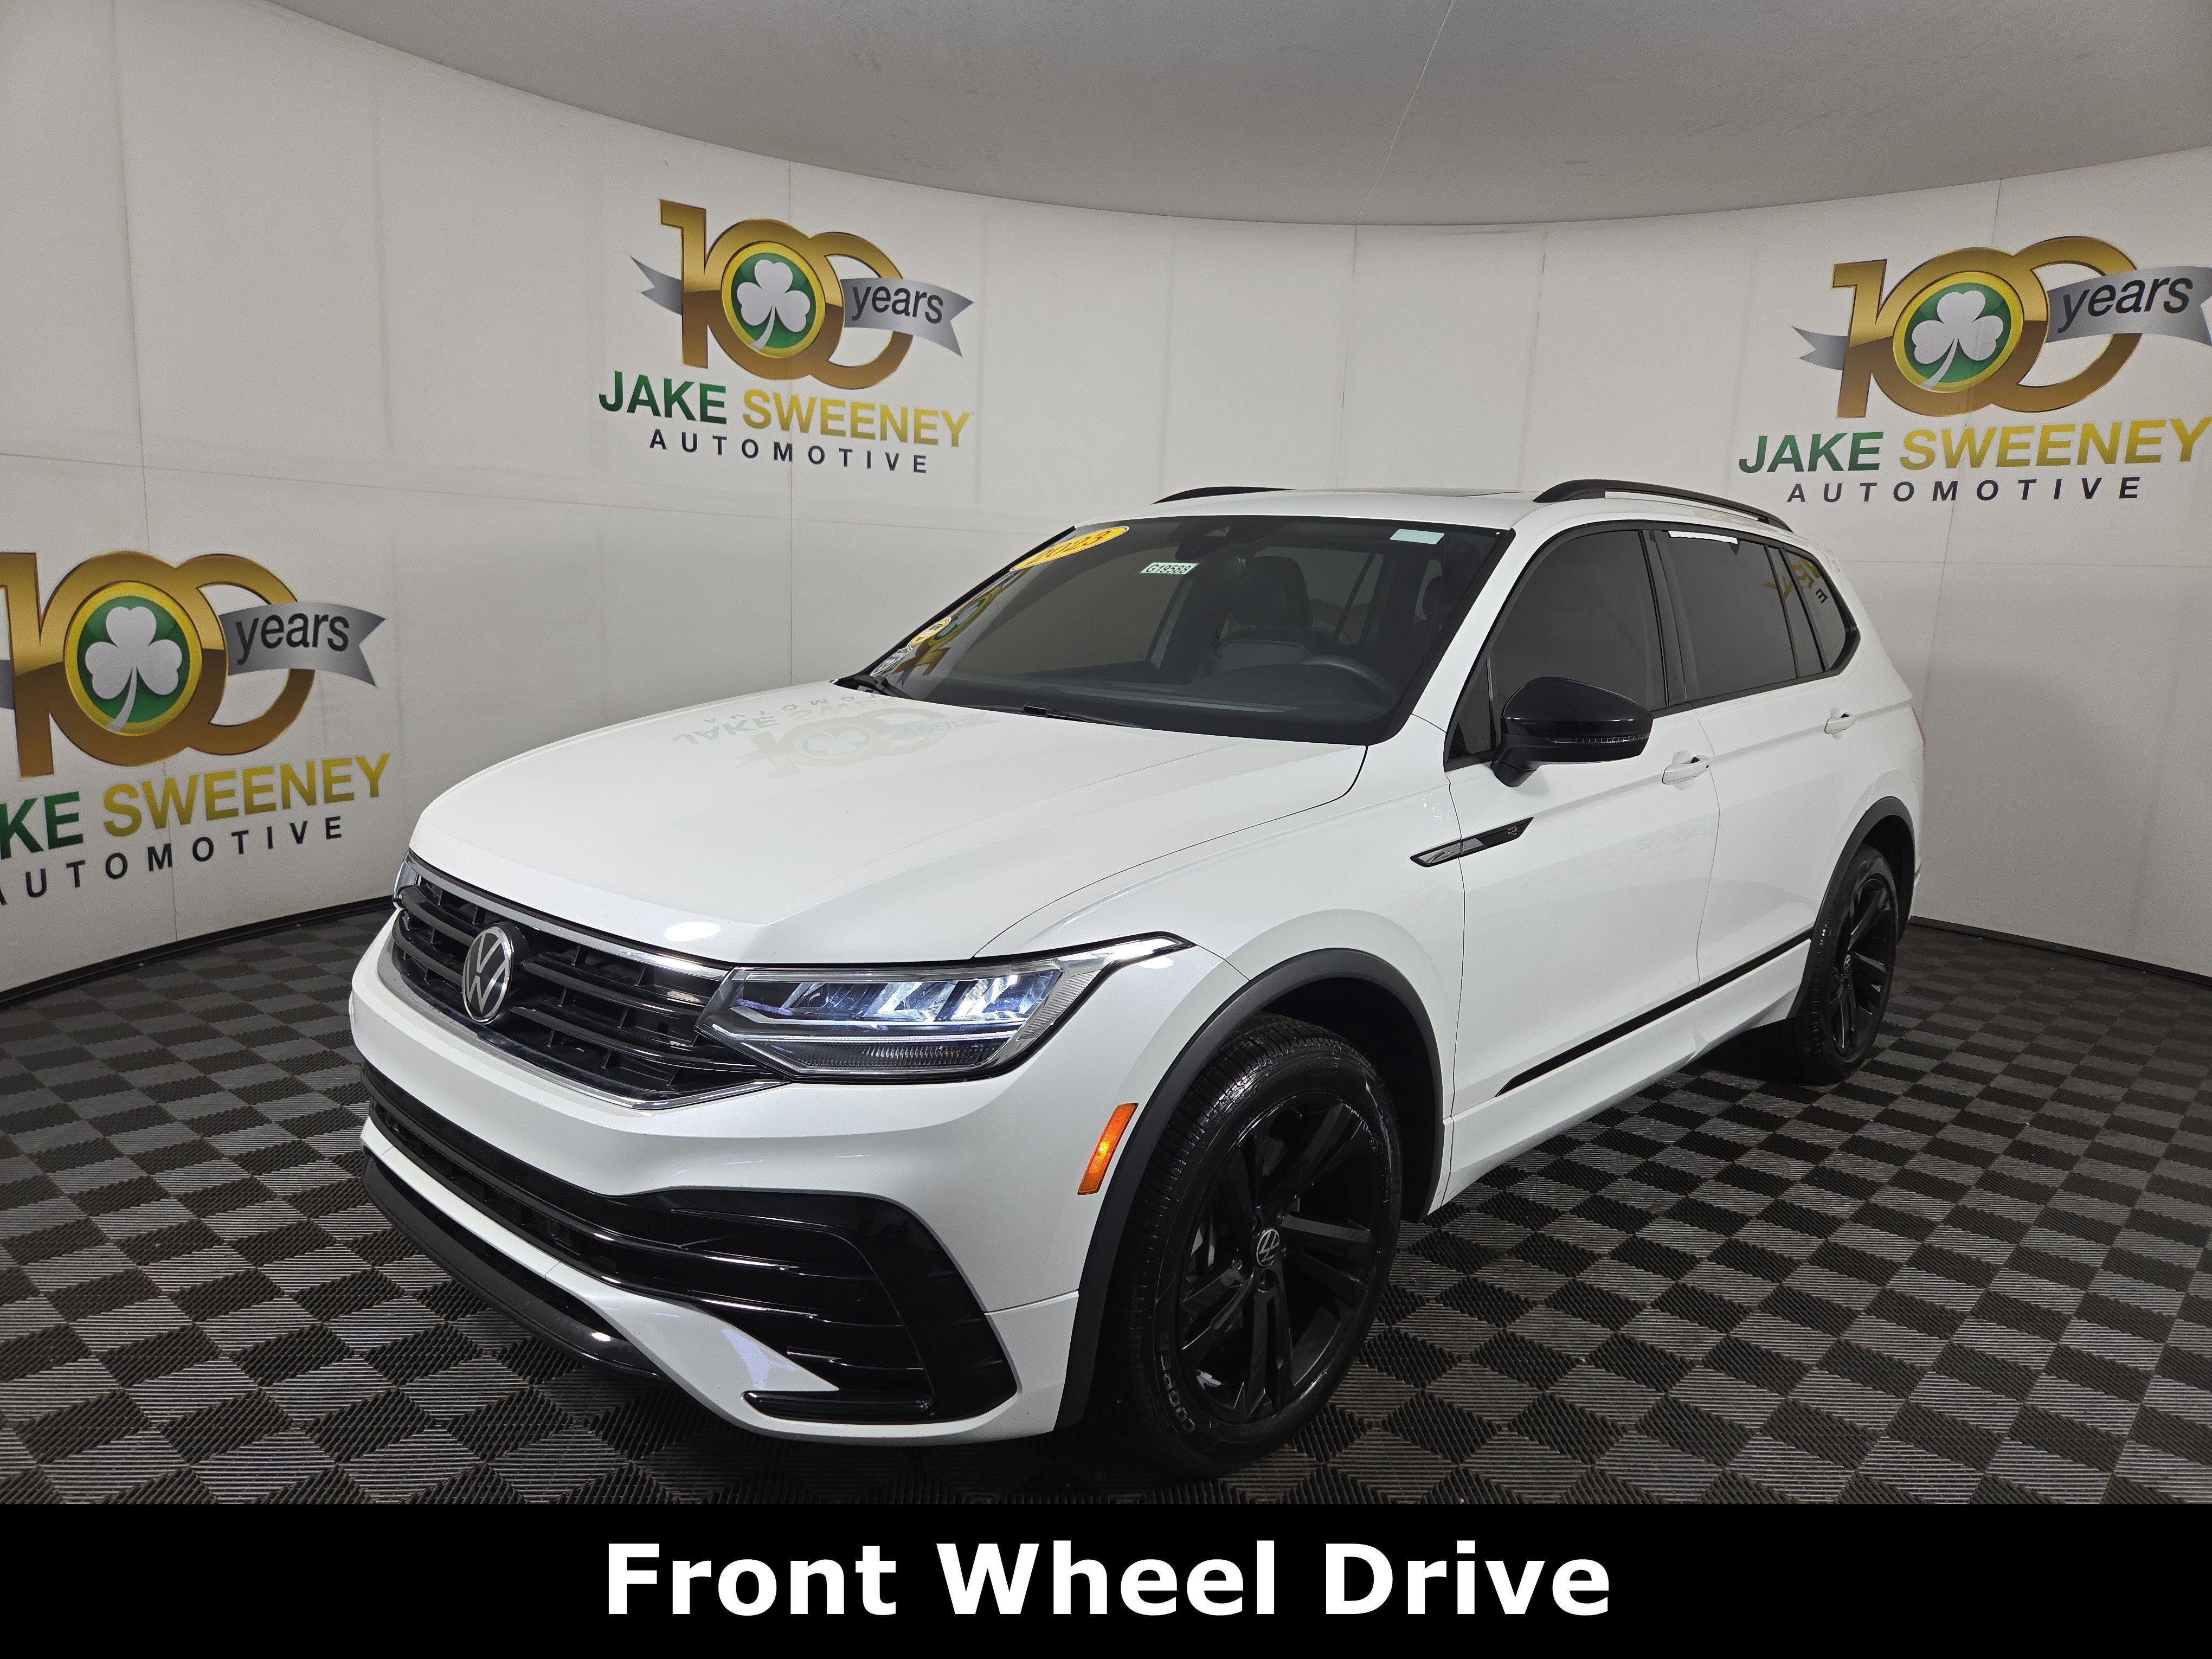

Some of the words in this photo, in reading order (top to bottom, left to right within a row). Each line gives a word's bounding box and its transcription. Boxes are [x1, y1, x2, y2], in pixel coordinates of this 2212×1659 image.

[659, 198, 914, 390] 100
[852, 284, 944, 323] years
[1831, 235, 2143, 418] 100
[2057, 275, 2193, 333] years
[599, 371, 727, 425] JAKE
[743, 389, 970, 447] SWEENEY
[650, 429, 927, 473] AUTOMOTIVE
[1739, 431, 1884, 473] JAKE
[1899, 416, 2212, 470] SWEENEY
[1786, 477, 2140, 502] AUTOMOTIVE
[1025, 530, 1113, 566] 2023
[1146, 563, 1192, 574] G19588
[235, 611, 350, 665] years
[104, 753, 391, 838] SWEENEY
